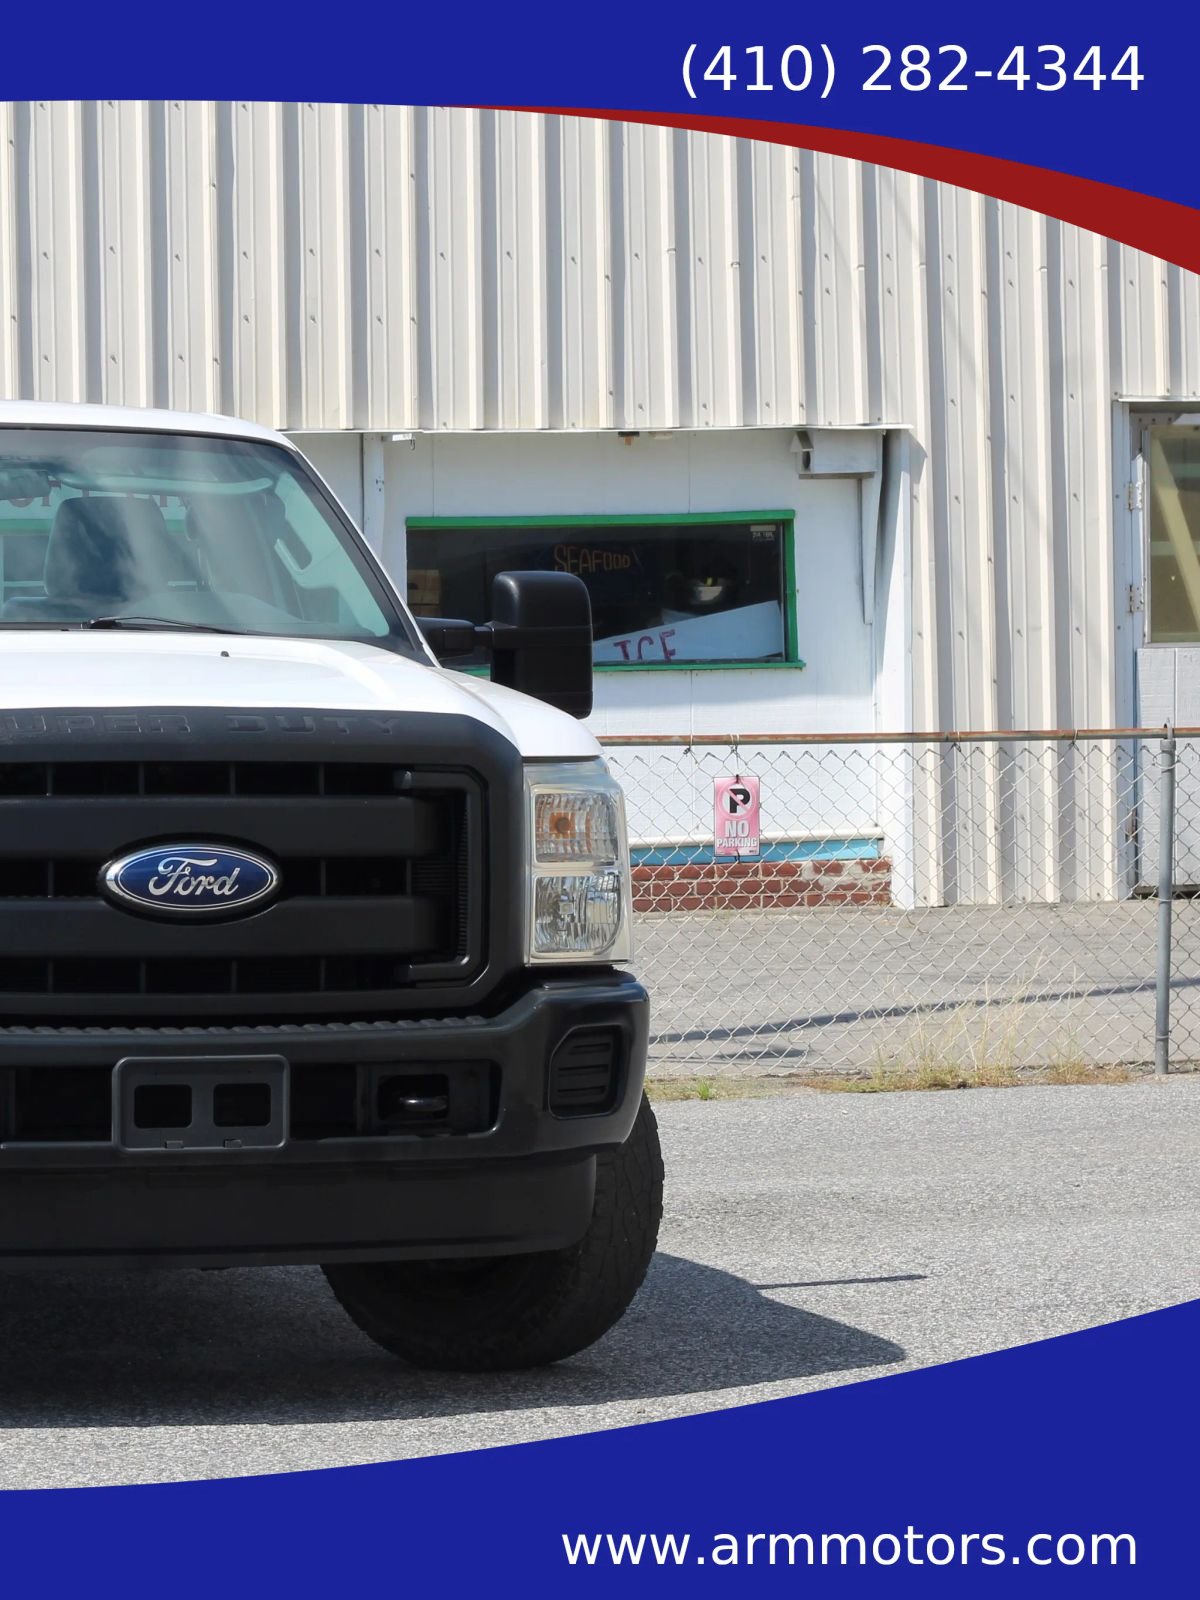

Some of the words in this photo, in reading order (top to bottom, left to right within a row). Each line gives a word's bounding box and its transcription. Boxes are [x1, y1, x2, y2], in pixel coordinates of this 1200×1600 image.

[224, 714, 400, 736] DUTY
[724, 820, 750, 837] NO
[717, 837, 757, 848] PARKING
[148, 857, 240, 896] Ford
